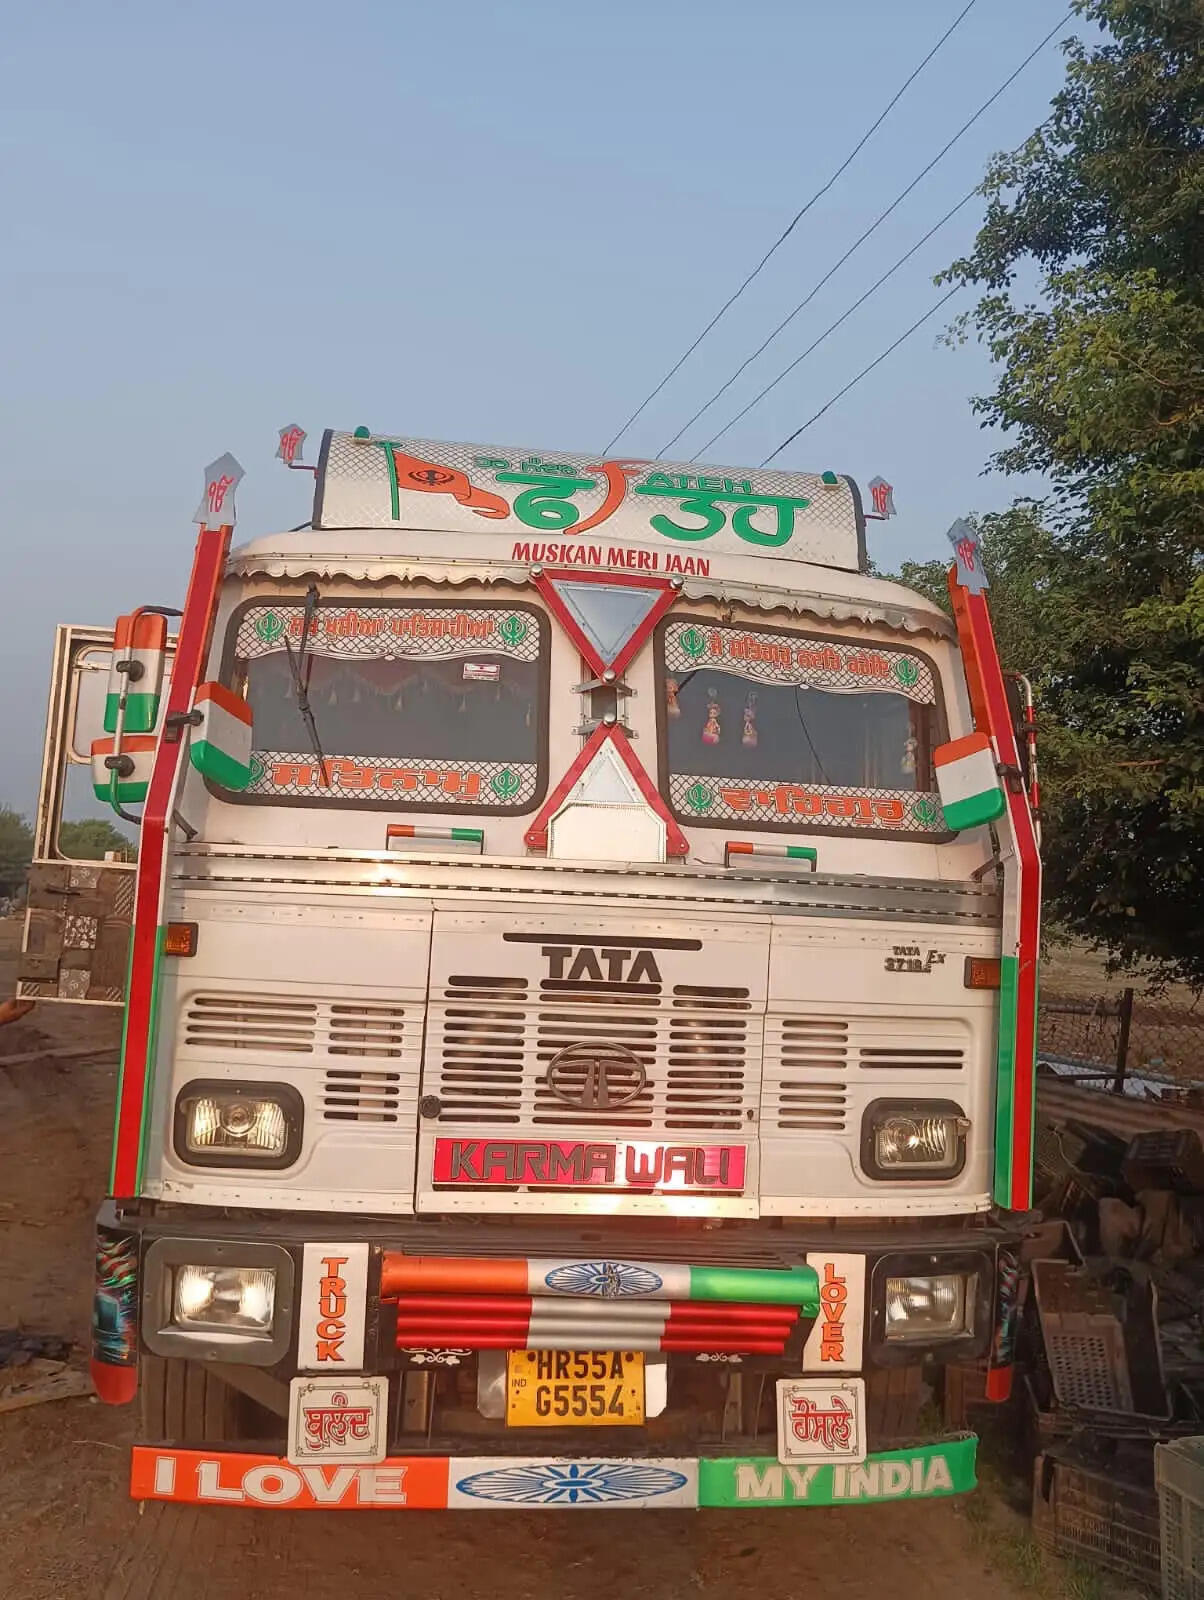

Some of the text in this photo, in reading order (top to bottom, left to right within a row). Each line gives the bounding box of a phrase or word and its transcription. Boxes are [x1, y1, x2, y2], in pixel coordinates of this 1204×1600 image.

[512, 543, 710, 577] MUSKAN MERI JAAN
[541, 946, 663, 983] TATA
[892, 946, 921, 957] TATA
[316, 1257, 351, 1362] TRUCK
[820, 1263, 848, 1362] LOVER
[536, 1350, 624, 1380] HR55A
[536, 1385, 624, 1416] G5554
[153, 1456, 408, 1505] I LOVE
[735, 1455, 953, 1500] MY INDIA
